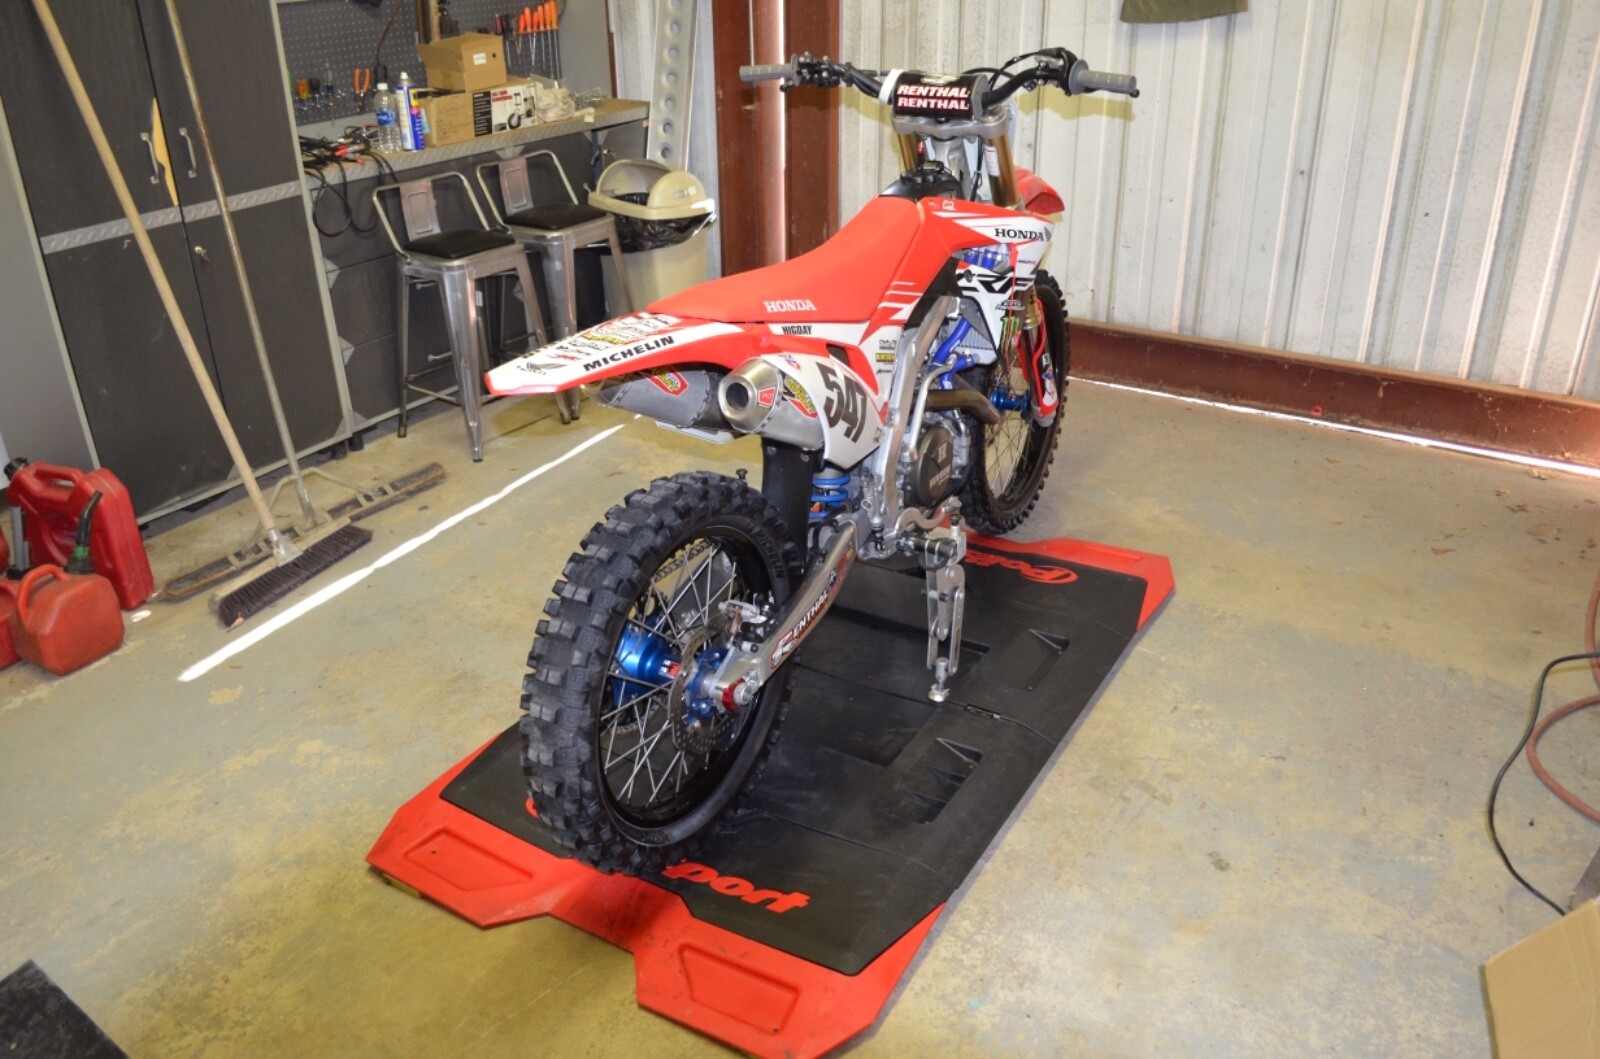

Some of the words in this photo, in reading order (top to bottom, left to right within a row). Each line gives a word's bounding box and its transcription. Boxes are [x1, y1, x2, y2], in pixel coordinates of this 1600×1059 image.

[897, 84, 970, 98] RENTHAL
[897, 97, 970, 110] RENTHAL
[994, 227, 1044, 241] HONDA
[763, 299, 817, 313] HONDA
[582, 335, 675, 372] MICHELIN
[816, 362, 867, 444] 547
[770, 589, 829, 671] RENTHAL
